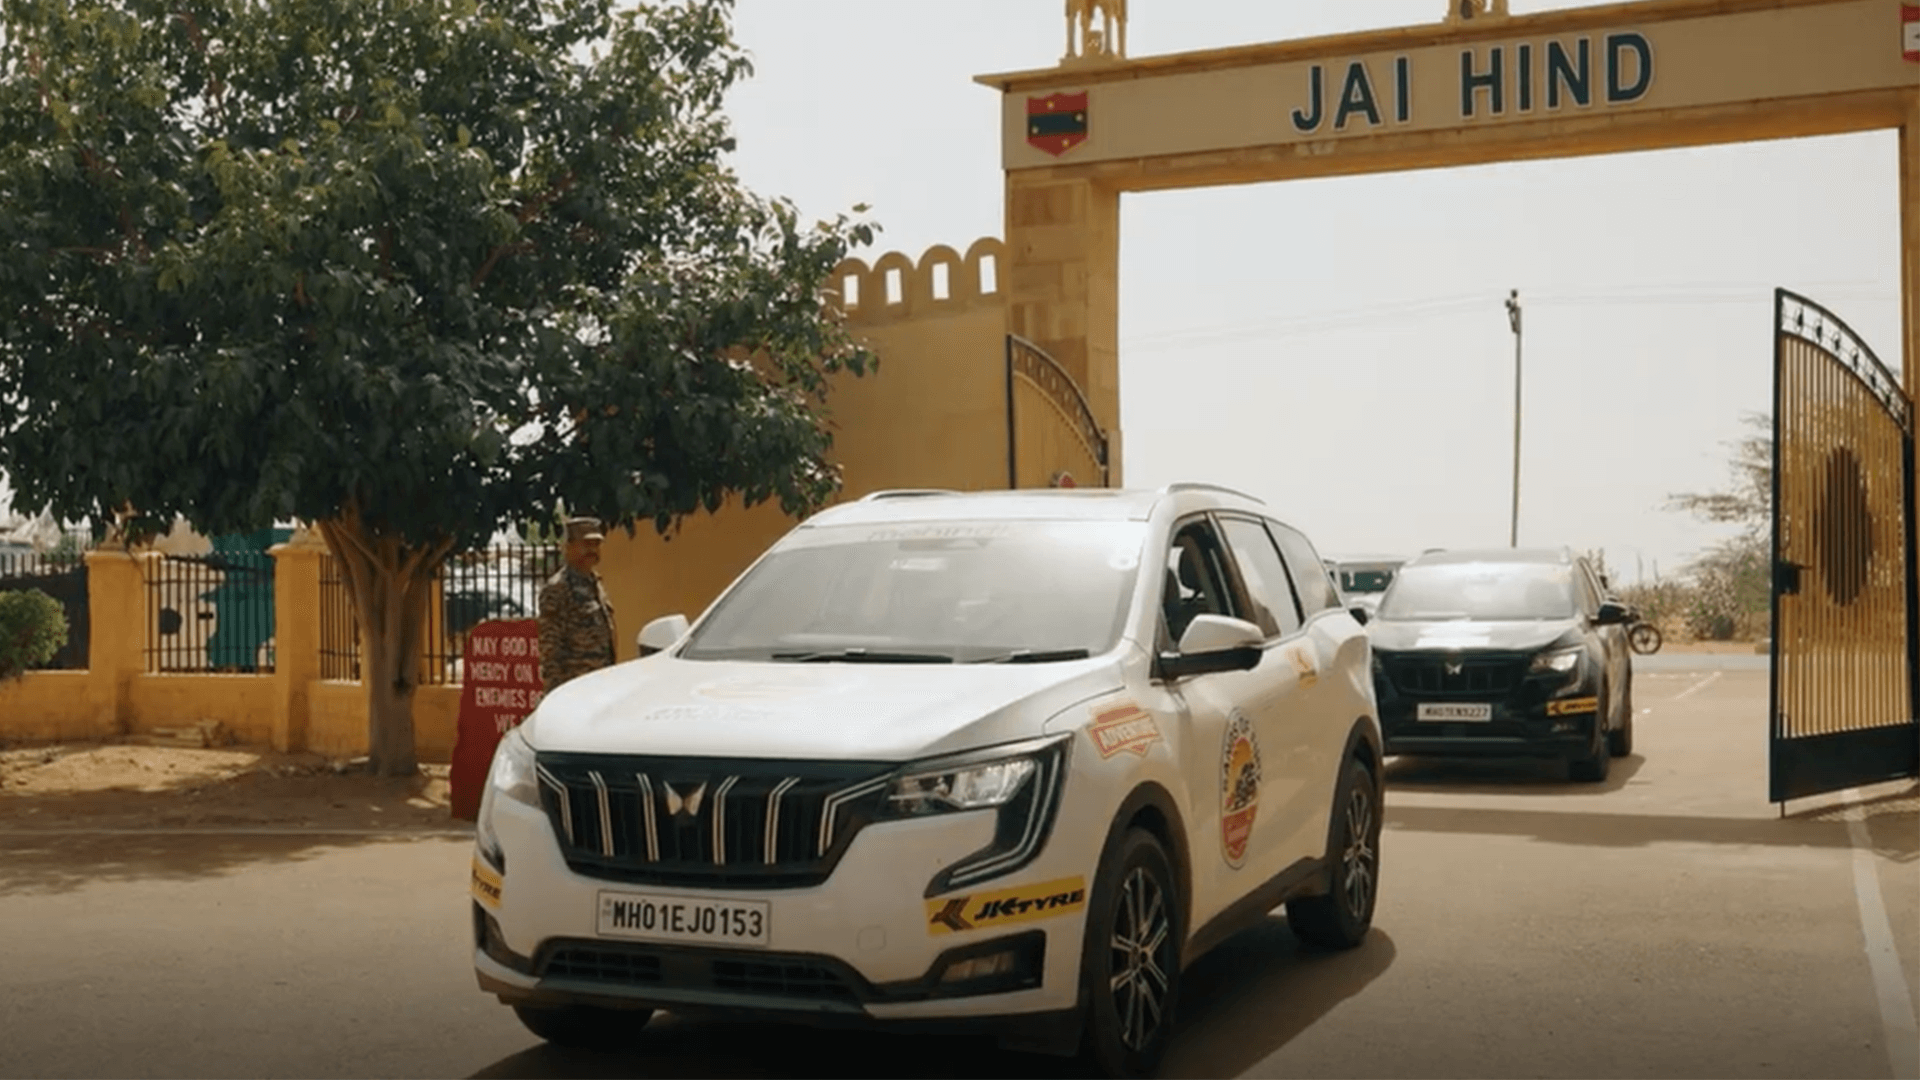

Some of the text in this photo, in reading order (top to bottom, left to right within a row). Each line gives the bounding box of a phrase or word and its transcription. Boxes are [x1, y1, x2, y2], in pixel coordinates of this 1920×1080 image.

[1291, 32, 1654, 132] JAI HIND
[473, 636, 499, 656] MAY
[501, 636, 528, 656] GOD
[470, 662, 510, 682] MERCY
[514, 664, 533, 683] ON
[475, 687, 527, 709] ENEMIES
[612, 901, 763, 937] MH01EJ0153
